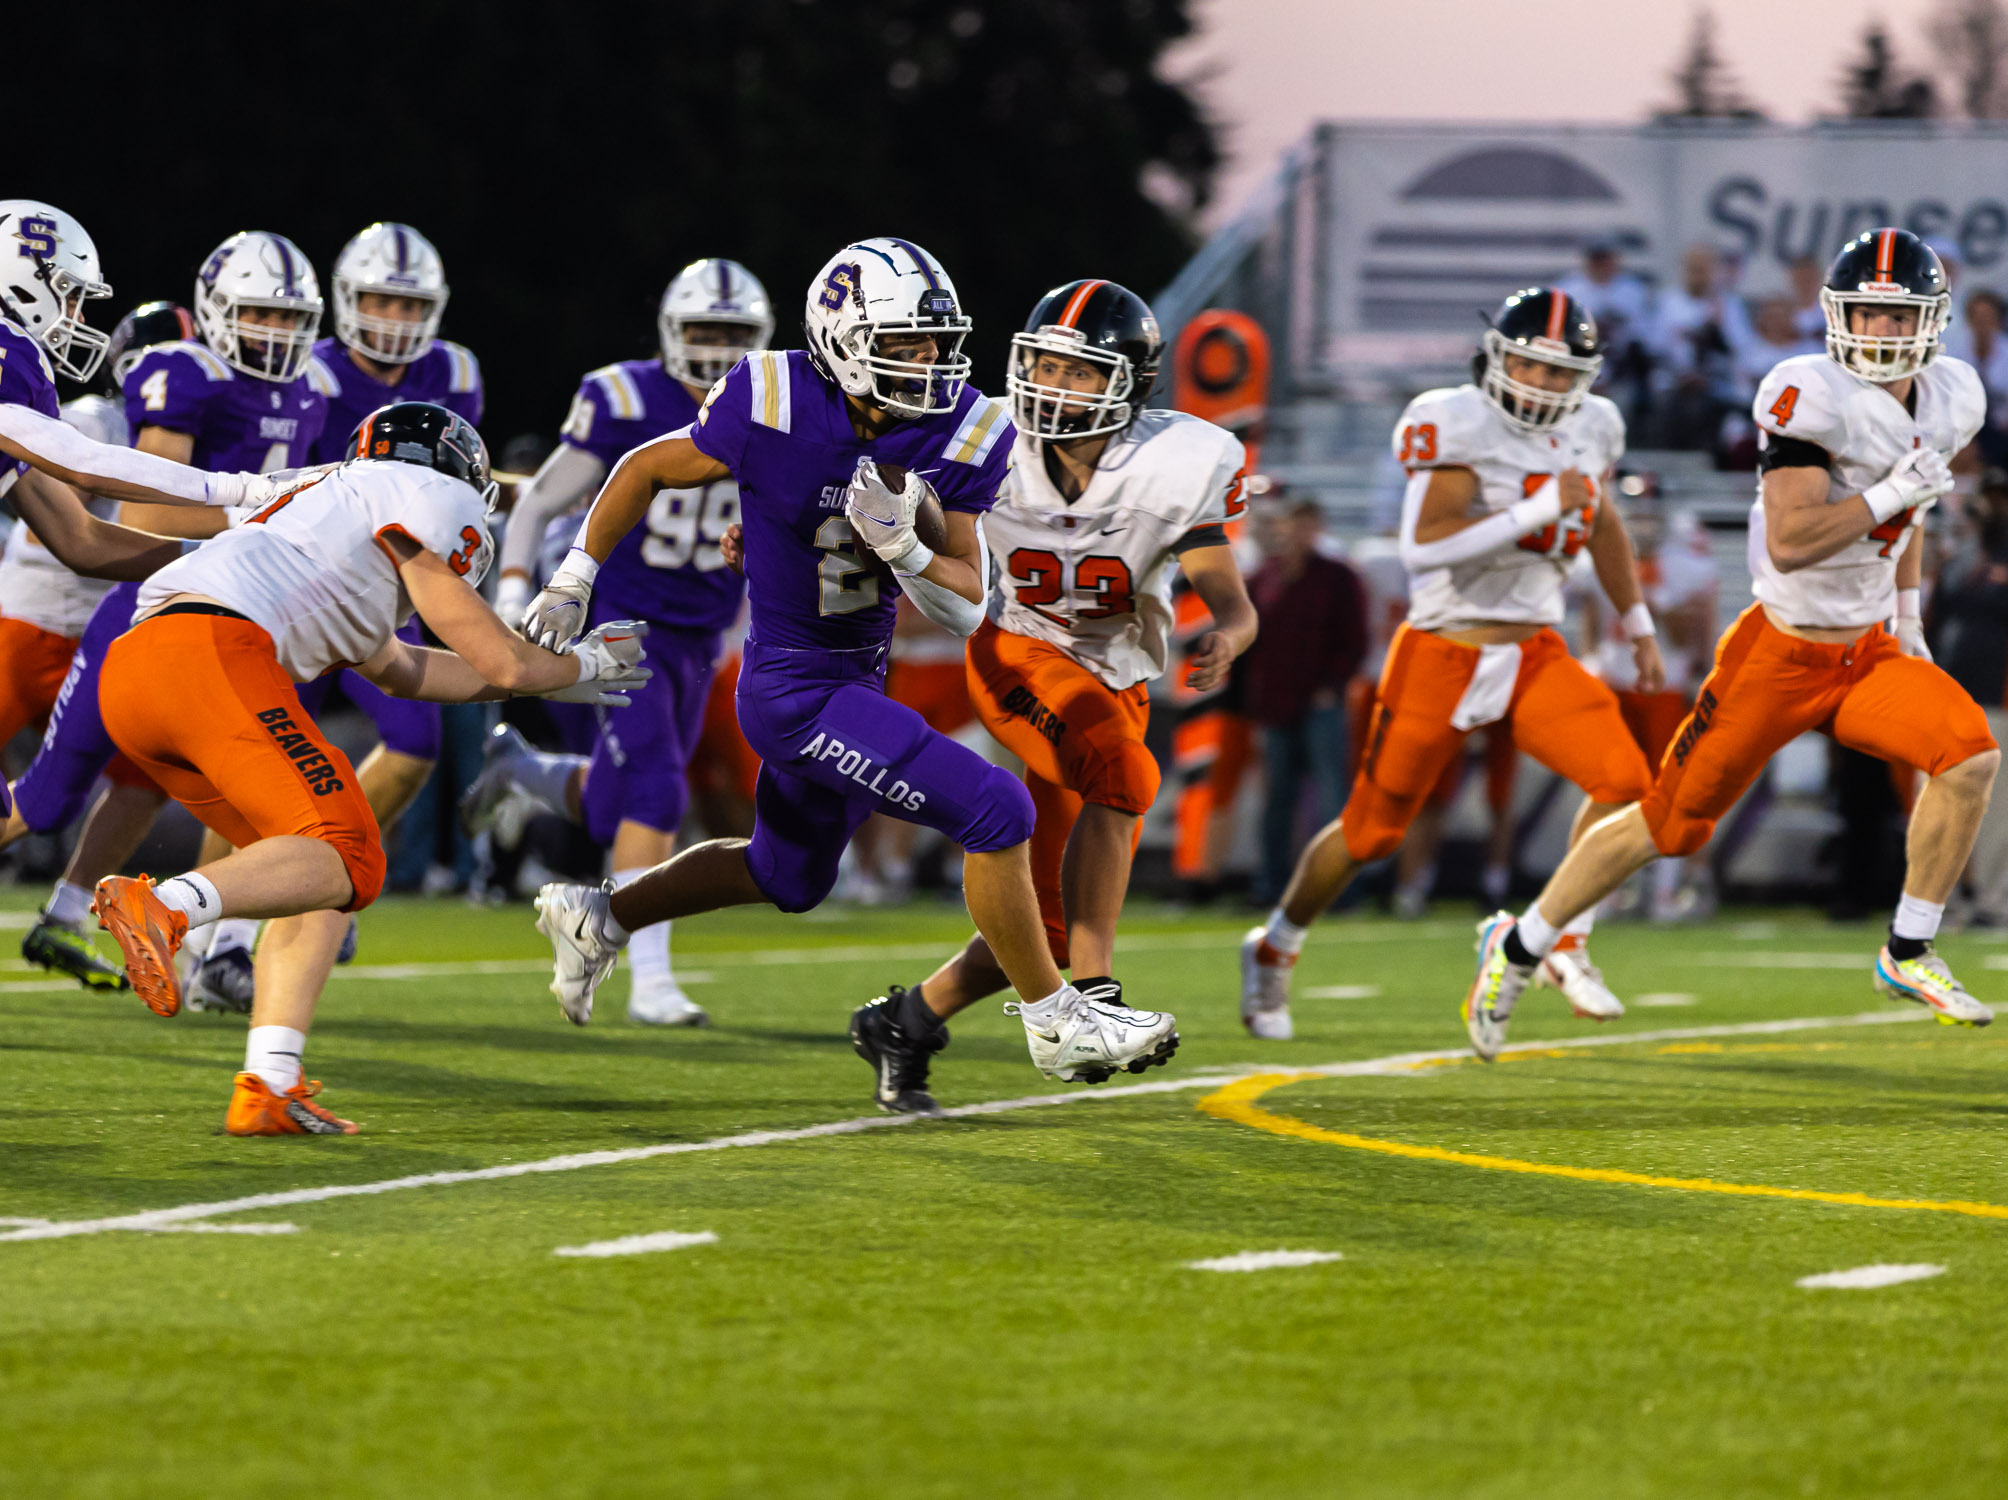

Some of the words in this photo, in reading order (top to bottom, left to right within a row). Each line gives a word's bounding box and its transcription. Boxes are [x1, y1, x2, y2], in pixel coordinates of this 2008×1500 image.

[820, 262, 862, 313] S
[933, 300, 944, 310] ALL
[140, 369, 169, 411] 4
[1769, 384, 1801, 428] 4
[447, 525, 482, 576] 3
[814, 515, 879, 617] 2
[1008, 547, 1136, 629] 23
[256, 706, 344, 797] BEAVERS
[799, 732, 926, 812] APOLLOS
